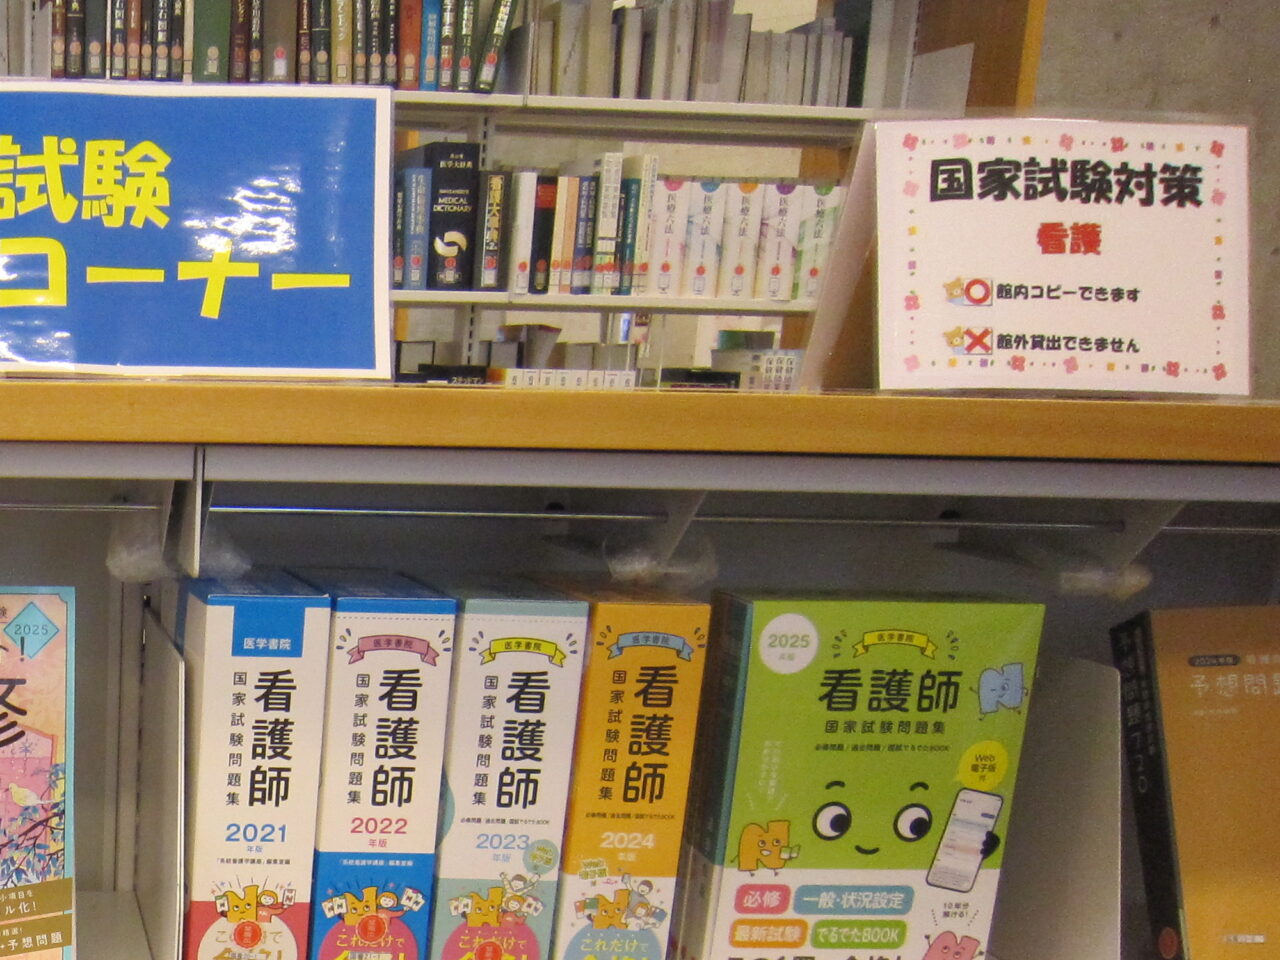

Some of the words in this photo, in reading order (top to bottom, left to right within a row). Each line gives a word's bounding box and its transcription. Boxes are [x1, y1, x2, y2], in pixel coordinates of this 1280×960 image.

[930, 157, 1204, 208] 国家試験対策
[432, 204, 473, 213] DICTIONARY
[438, 196, 467, 205] MEDICAL
[1037, 222, 1103, 255] 看護
[996, 283, 1141, 303] 館内コピーできます
[996, 334, 1141, 353] 館外貸出できません
[14, 624, 49, 636] 2025
[243, 636, 291, 651] 医学書院
[766, 634, 810, 649] 2025
[818, 668, 964, 714] 看護師
[599, 669, 627, 802] 国家試験問題集
[622, 664, 680, 805] 看護師
[824, 720, 947, 735] 国家試験問題集
[226, 672, 247, 806] 国家試験問題集
[247, 669, 297, 808] 看護師
[347, 674, 371, 804] 国家試験問題集
[371, 668, 423, 808] 看護師
[471, 675, 498, 806] 国家試験問題集
[495, 670, 552, 809] 看護師
[225, 823, 287, 843] 2021
[350, 818, 408, 835] 2022
[476, 834, 530, 850] 2023
[599, 832, 655, 850] 2024
[743, 892, 782, 909] 必修
